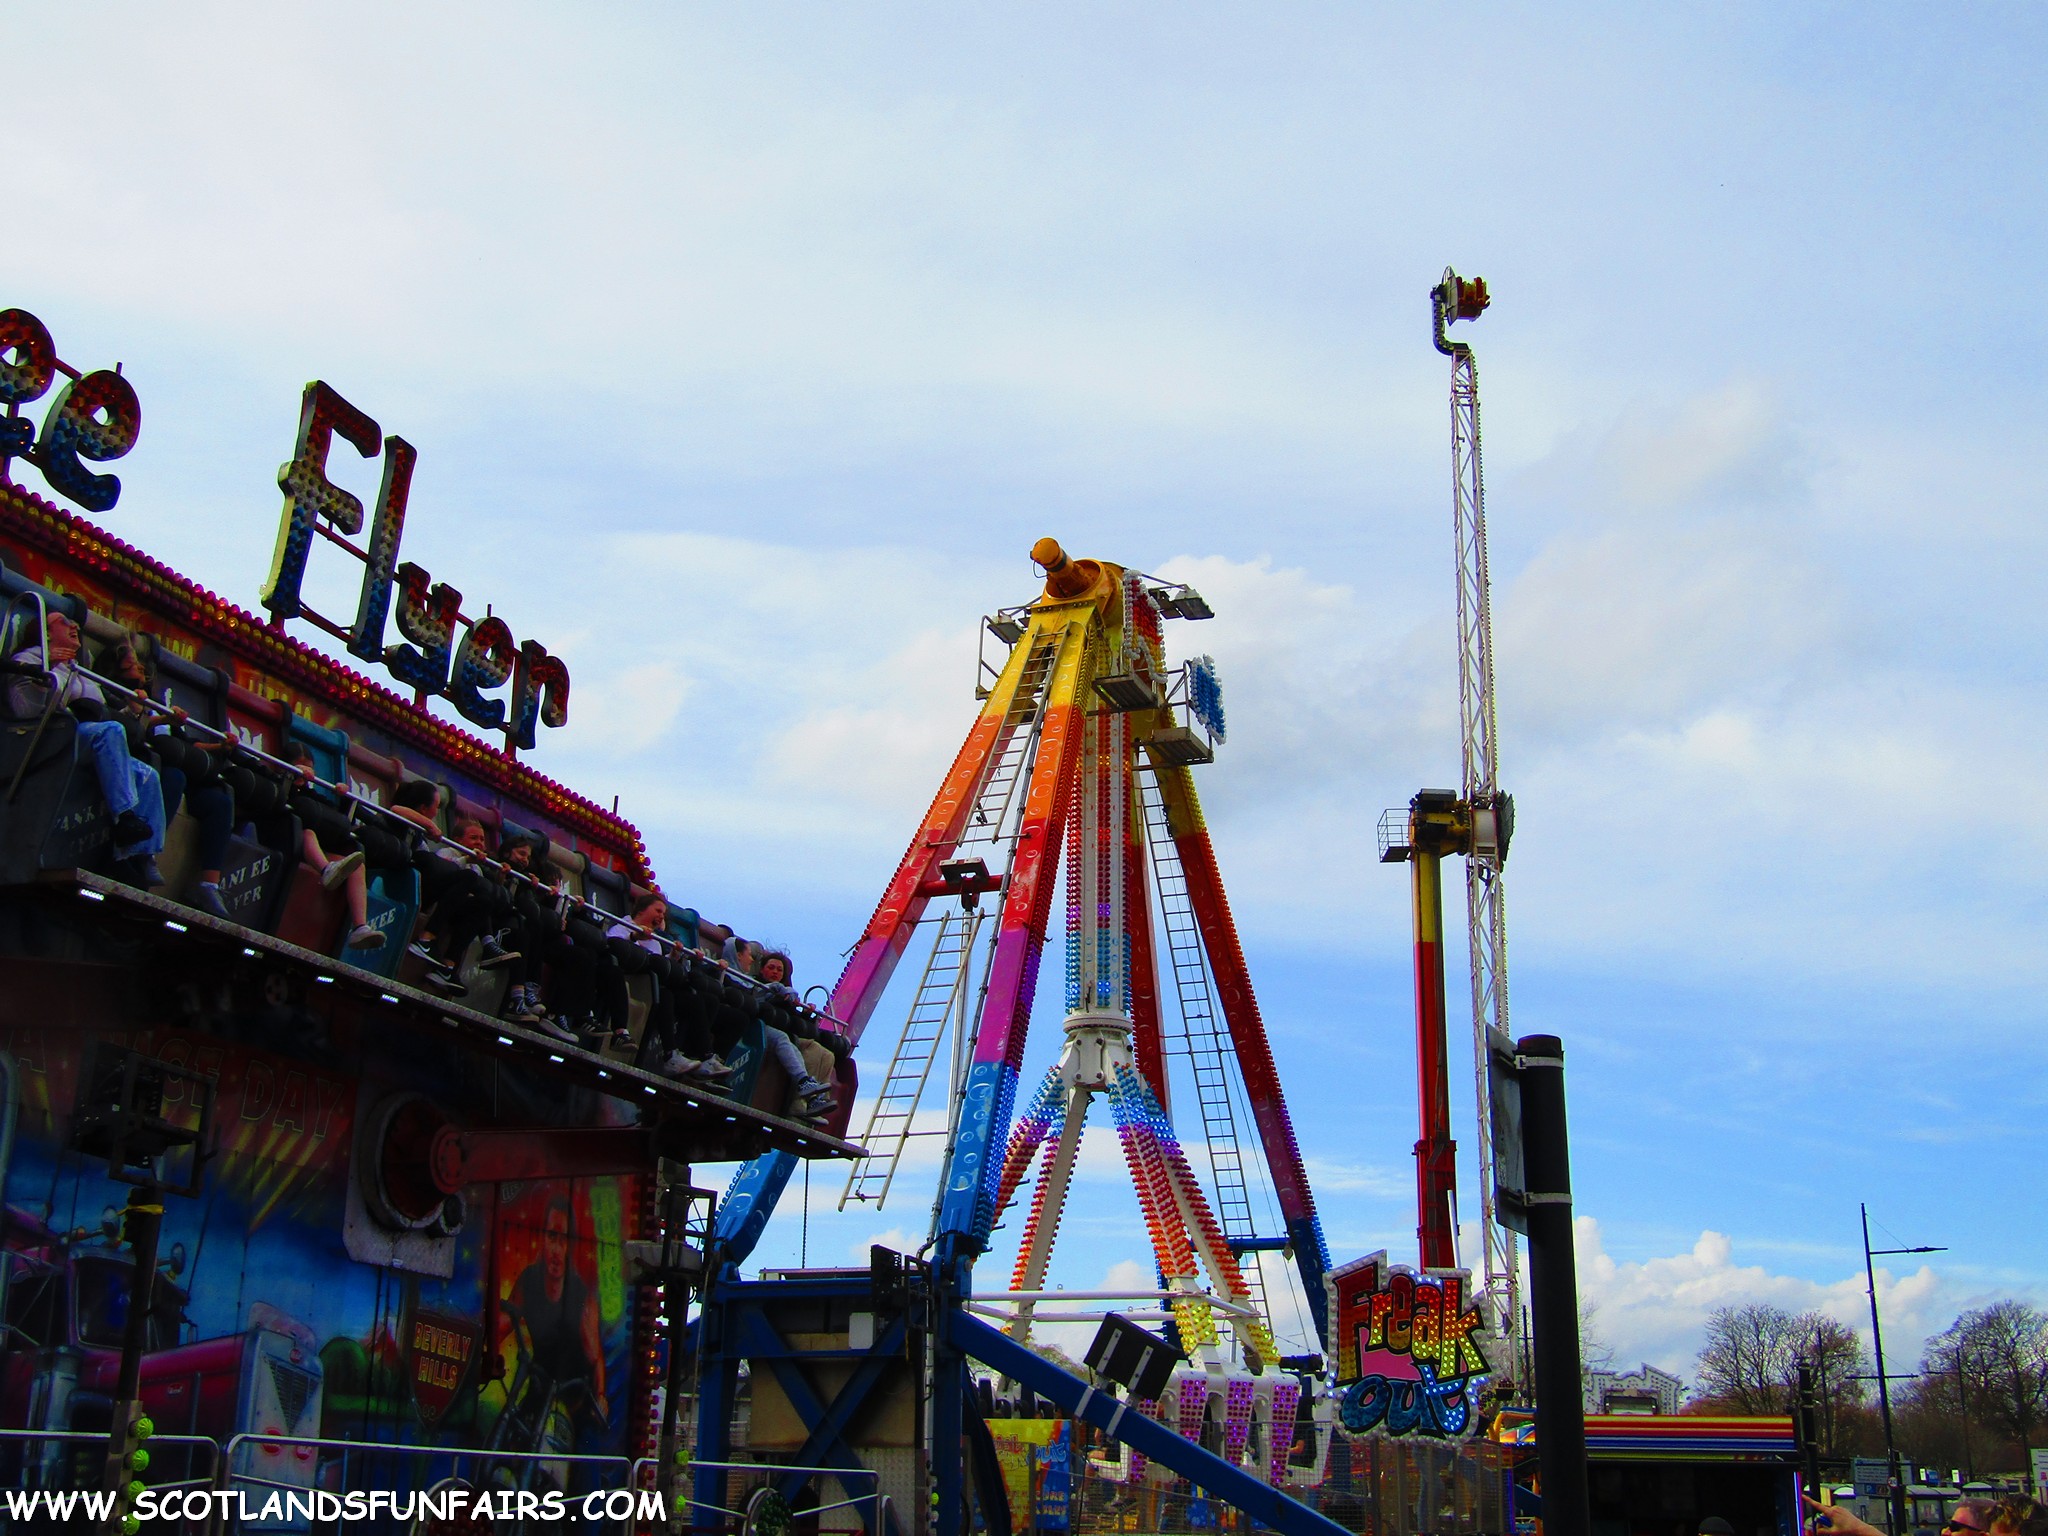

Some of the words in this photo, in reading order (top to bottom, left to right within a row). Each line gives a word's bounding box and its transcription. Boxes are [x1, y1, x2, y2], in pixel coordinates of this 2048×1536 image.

[261, 380, 570, 750] Flyer
[241, 1059, 345, 1138] DAY
[414, 1321, 472, 1362] BEVERLY
[1333, 1262, 1490, 1386] Freak
[418, 1356, 458, 1390] HILLS
